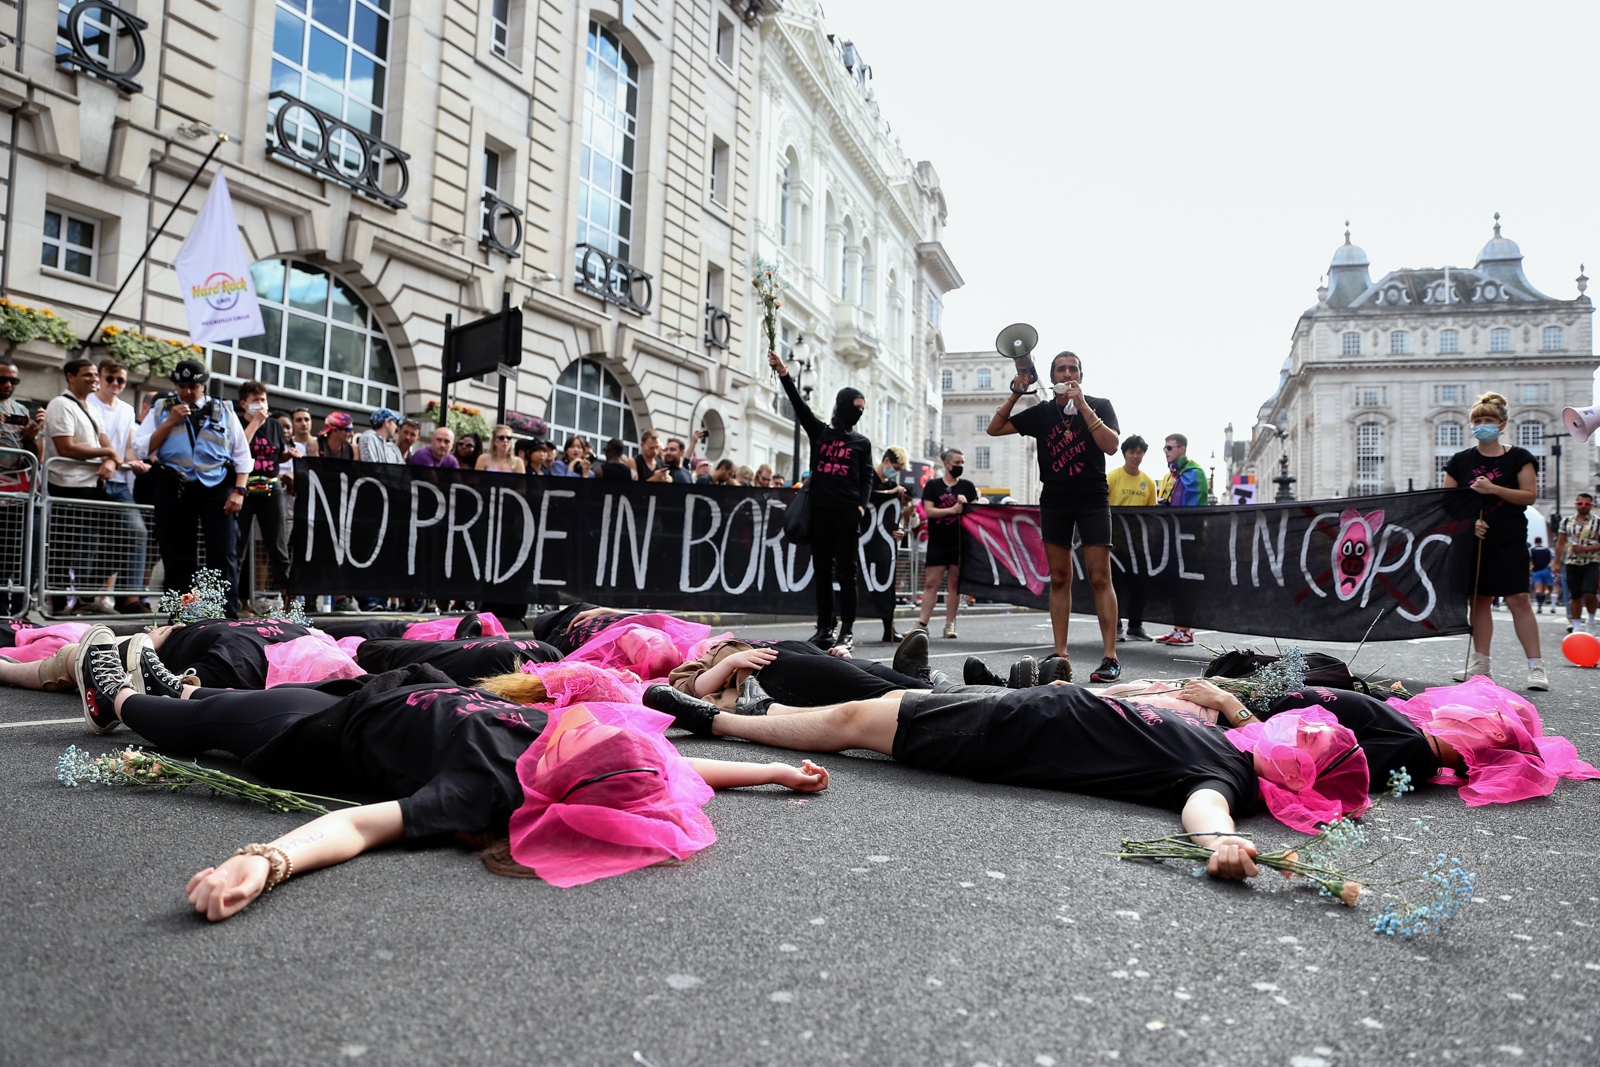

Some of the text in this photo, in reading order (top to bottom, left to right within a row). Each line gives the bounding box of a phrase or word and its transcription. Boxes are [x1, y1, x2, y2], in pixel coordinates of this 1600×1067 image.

[192, 276, 248, 299] Hard Rock
[250, 445, 277, 457] RIDE
[820, 443, 852, 459] PRIDE
[1052, 441, 1086, 473] CONSENT
[254, 459, 275, 472] OPS
[817, 460, 850, 476] COPS
[1122, 488, 1147, 498] STEWARD
[305, 469, 901, 595] NO PRIDE IN BORRS
[978, 514, 1051, 586] NO
[1228, 508, 1289, 587] IN
[1300, 511, 1453, 622] COPS
[256, 625, 285, 638] NO
